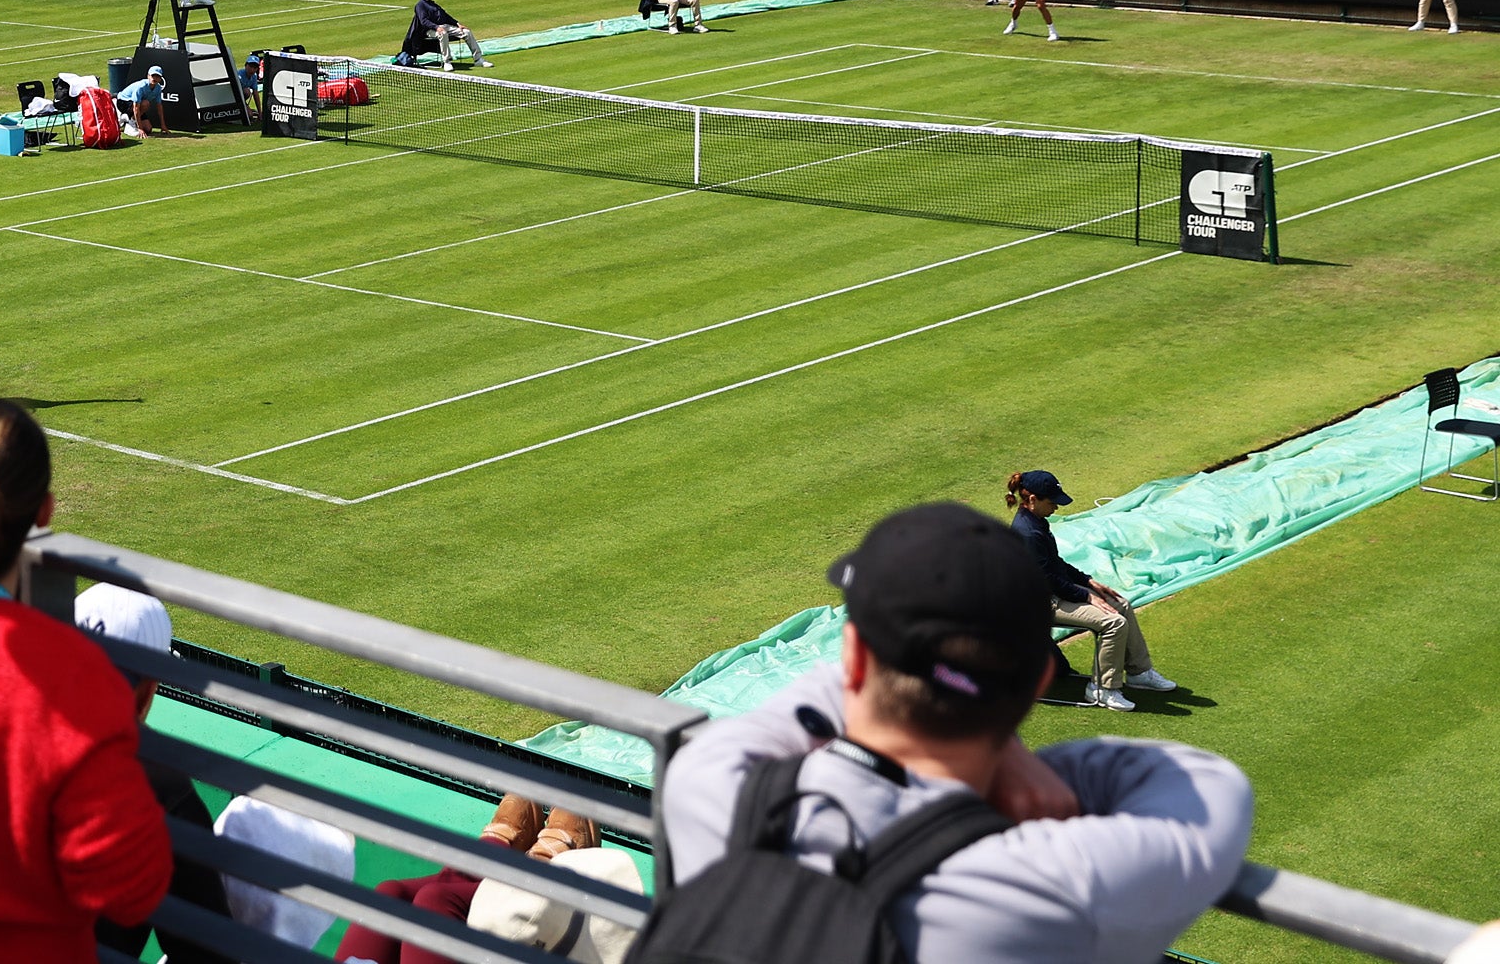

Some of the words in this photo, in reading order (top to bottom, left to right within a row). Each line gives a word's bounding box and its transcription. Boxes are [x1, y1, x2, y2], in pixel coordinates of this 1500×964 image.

[213, 109, 240, 119] LEXUS
[271, 104, 312, 118] CHALLENGER
[271, 113, 289, 123] TOUR
[1187, 214, 1255, 232] CHALLENGER
[1187, 225, 1216, 238] TOUR
